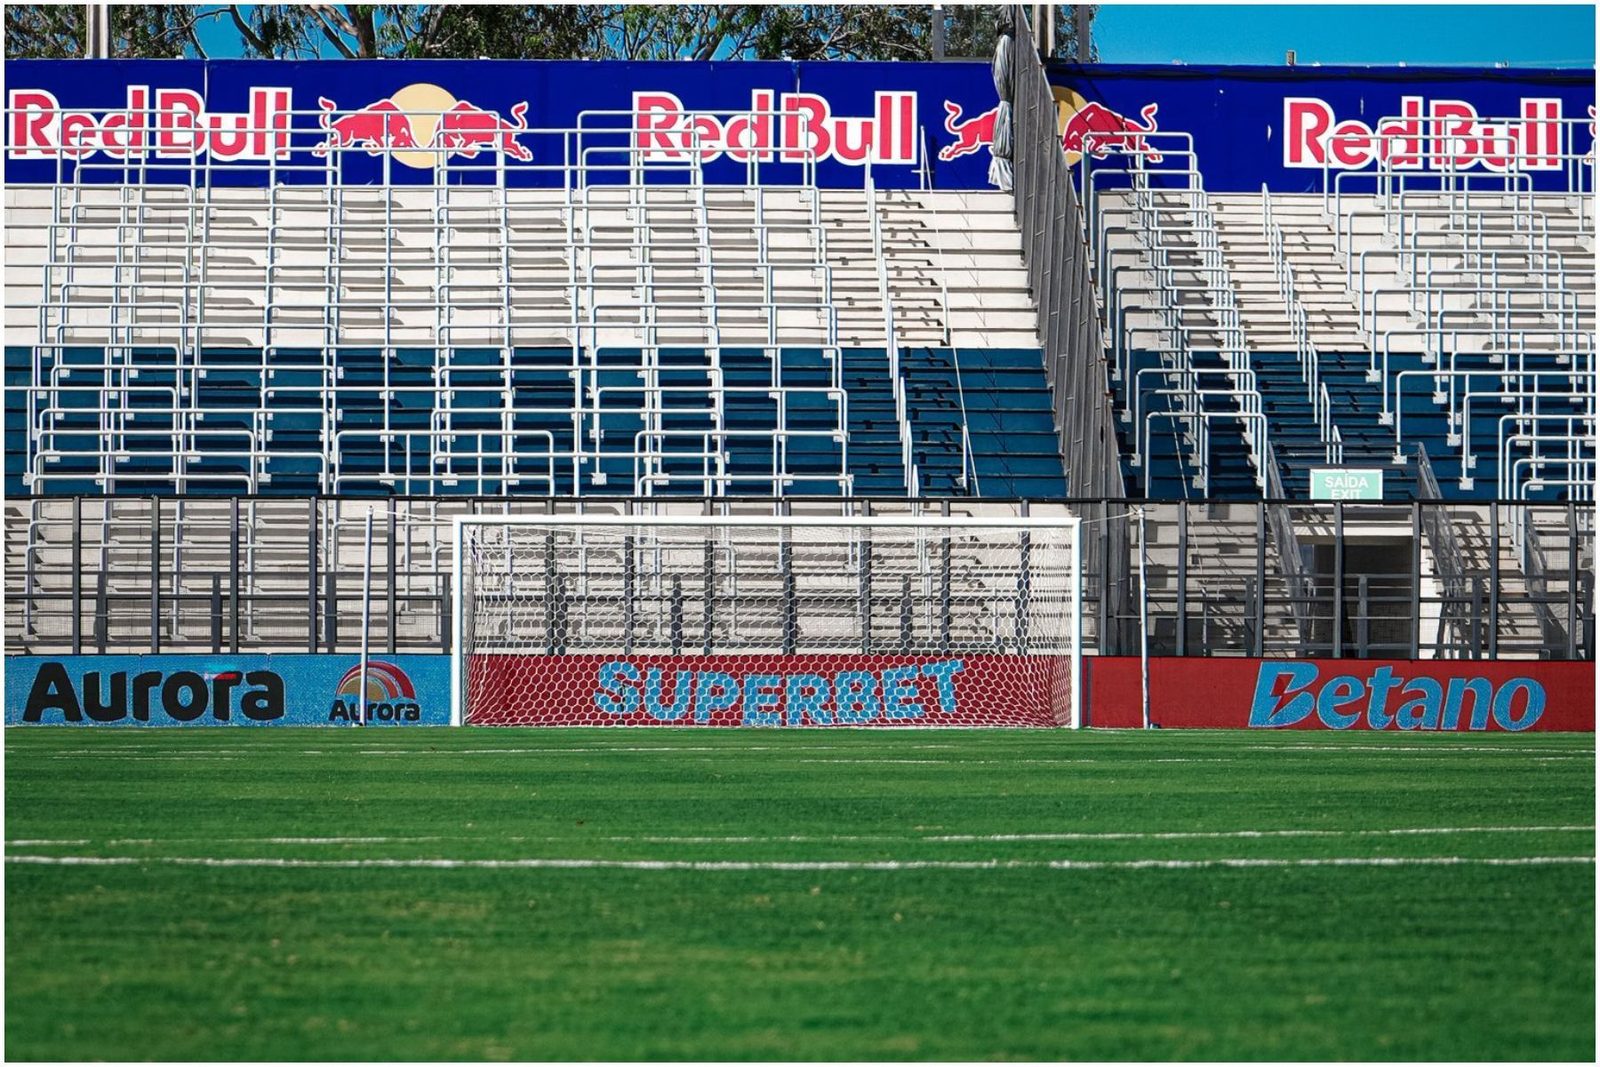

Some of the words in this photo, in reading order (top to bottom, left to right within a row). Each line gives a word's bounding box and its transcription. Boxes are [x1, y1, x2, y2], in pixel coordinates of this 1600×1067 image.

[9, 85, 149, 160] Red
[156, 87, 292, 161] Bull
[632, 89, 774, 163] Red
[780, 91, 917, 165] Bull
[1284, 96, 1423, 169] Red
[1429, 98, 1562, 171] Bull
[1324, 473, 1369, 489] SAÍDA
[1331, 489, 1362, 500] EXIT
[23, 662, 285, 722] Aurora
[329, 699, 420, 722] Aurora
[594, 659, 964, 727] SUPERBET
[1248, 661, 1547, 731] Betano
